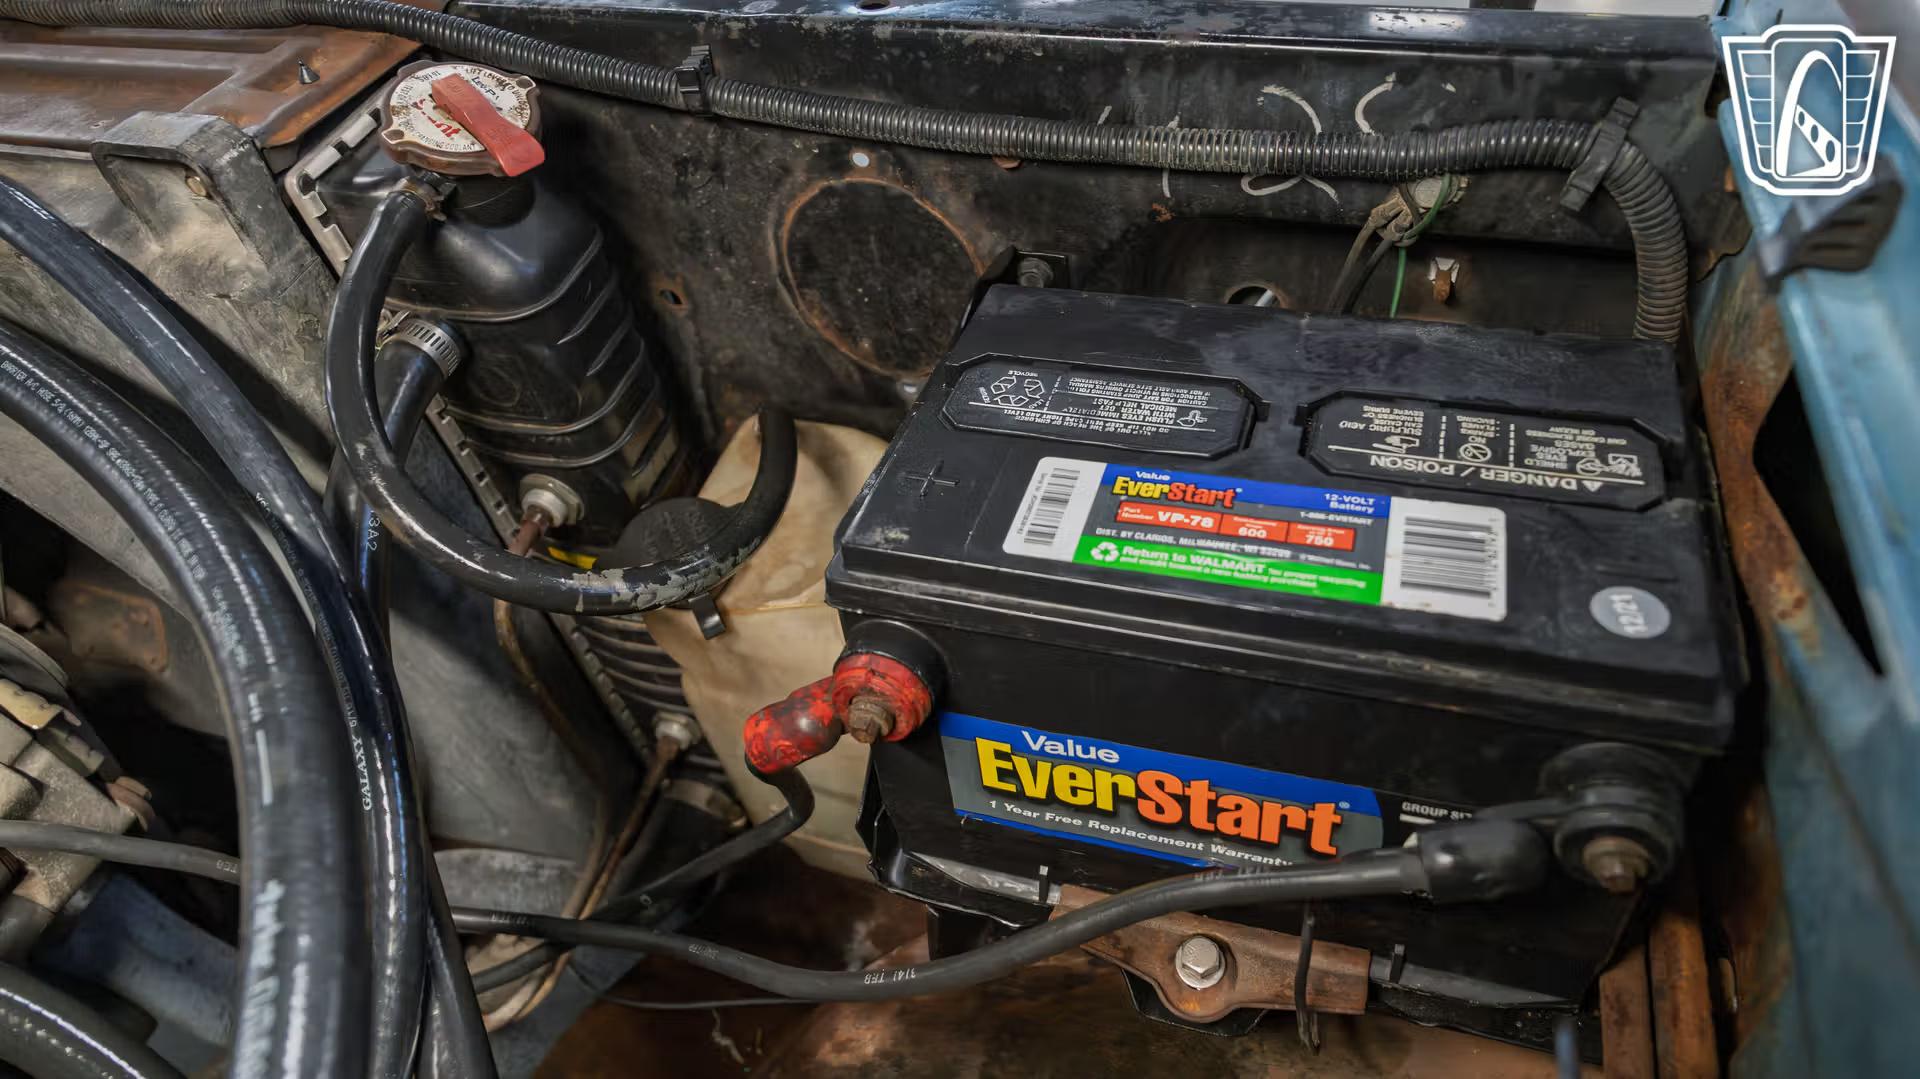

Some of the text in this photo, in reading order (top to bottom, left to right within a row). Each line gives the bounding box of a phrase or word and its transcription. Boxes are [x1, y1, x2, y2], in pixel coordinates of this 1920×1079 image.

[1092, 398, 1177, 413] MEDICAL HELP FAST
[1062, 407, 1174, 425] FLUSH EYES IMMEDIATELY
[1152, 410, 1175, 419] WITH
[1378, 413, 1424, 423] BLINDNESS
[1392, 409, 1424, 417] SEVERE
[1338, 420, 1423, 436] SULFURIC ACID
[1373, 418, 1400, 427] CAUSE
[1468, 435, 1487, 444] NO
[1554, 439, 1596, 450] GASES
[1530, 444, 1596, 457] EXPLOSIVE
[1535, 451, 1568, 462] EYES
[1370, 455, 1455, 476] POISON
[1524, 458, 1568, 470] SHIELD
[1135, 470, 1170, 481] Value
[1480, 467, 1578, 490] DANGER
[1112, 476, 1237, 508] EverStart
[1324, 493, 1376, 505] 12-VOLT
[1123, 506, 1141, 514] Part
[1329, 502, 1374, 514] Battery
[1121, 511, 1154, 521] Number
[1157, 511, 1214, 529] VP-78
[1096, 528, 1118, 538] DIST.
[1121, 530, 1133, 538] BY
[1238, 526, 1267, 539] 600
[1305, 534, 1335, 546] 750
[1122, 545, 1169, 560] Return
[1172, 553, 1187, 563] to
[1190, 554, 1266, 573] WALMART
[1021, 730, 1120, 763] Value
[352, 734, 372, 811] GALAXY
[975, 737, 1342, 856] EverStart
[1402, 801, 1449, 817] GROUP
[989, 800, 997, 809] 1
[1004, 803, 1040, 820] Year
[1045, 812, 1083, 827] Free
[1088, 819, 1204, 851] Replacement
